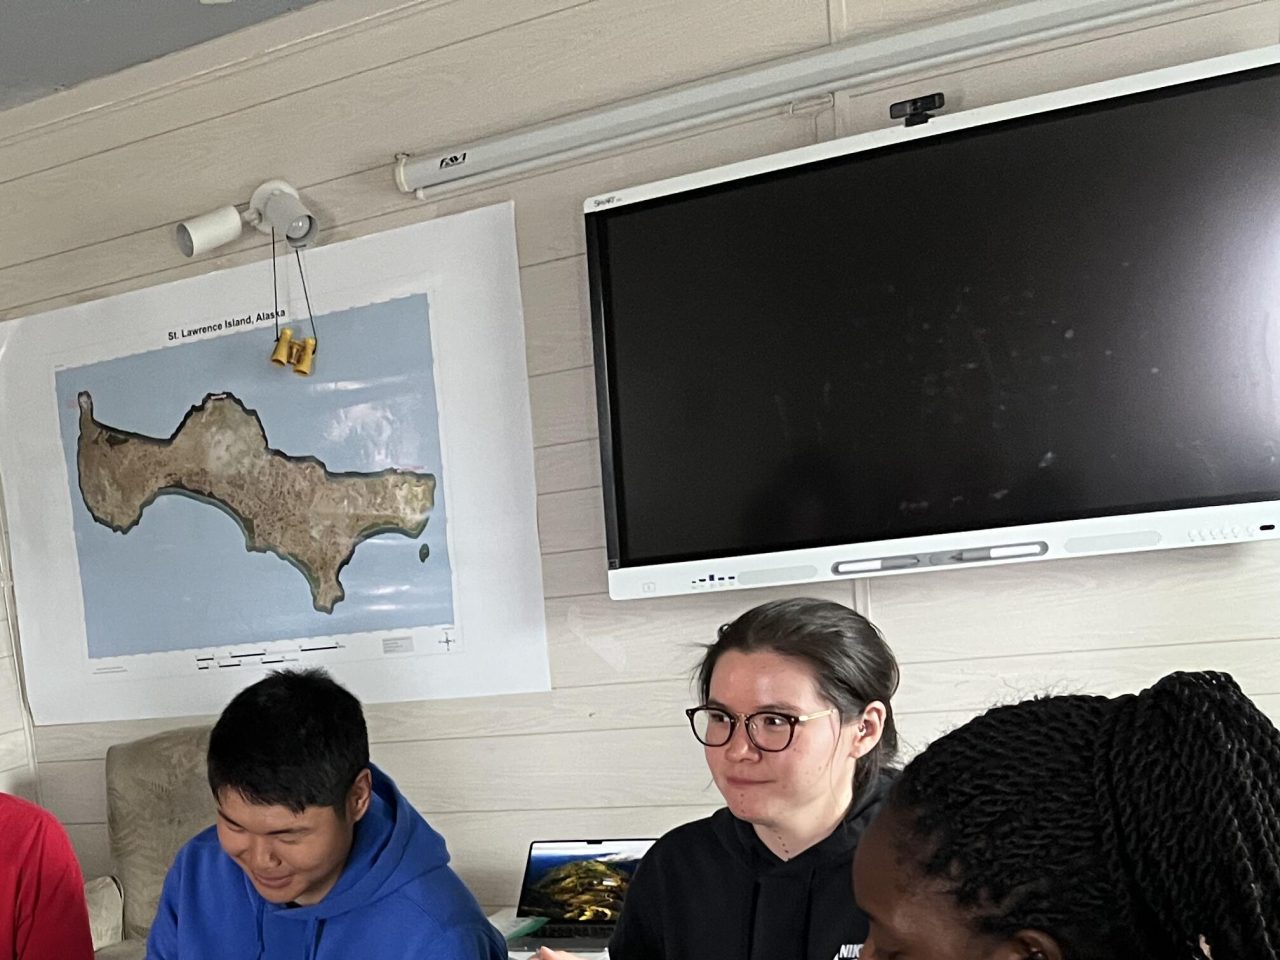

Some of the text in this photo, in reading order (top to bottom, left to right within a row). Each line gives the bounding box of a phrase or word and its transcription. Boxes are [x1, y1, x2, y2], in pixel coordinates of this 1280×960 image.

[168, 308, 285, 341] St. Lawrence Island, Alaska
[839, 943, 865, 958] NIK
